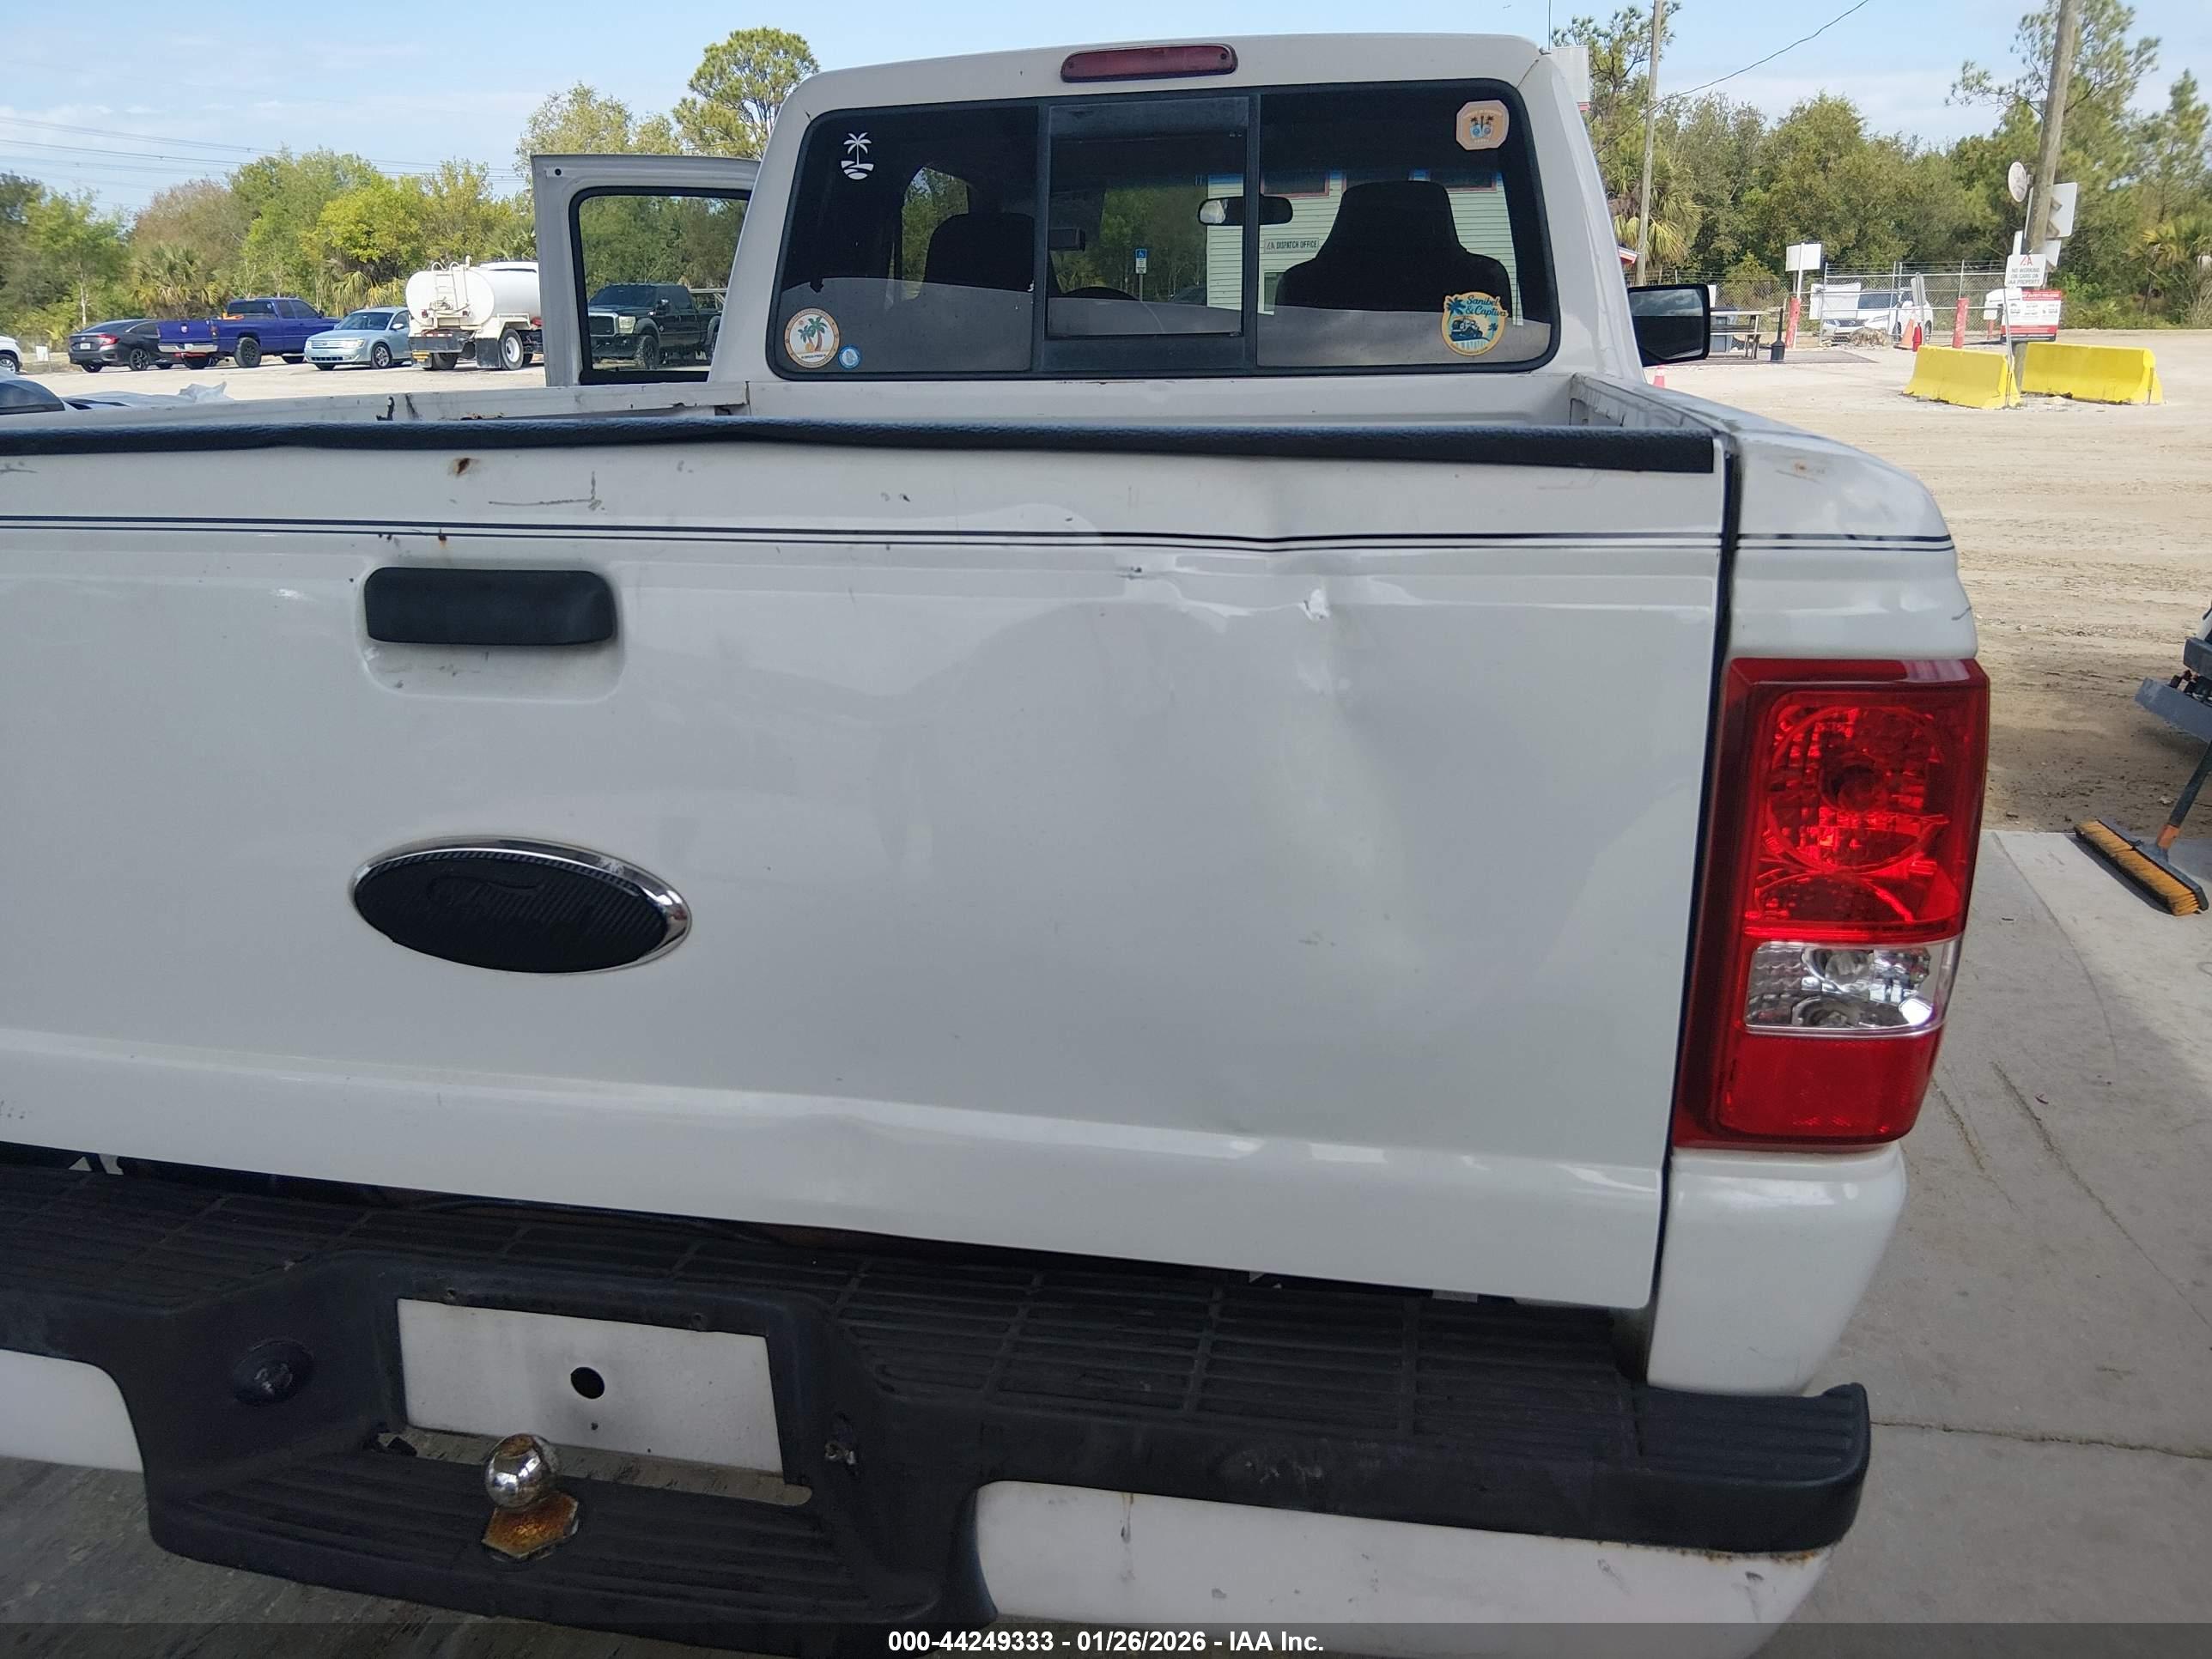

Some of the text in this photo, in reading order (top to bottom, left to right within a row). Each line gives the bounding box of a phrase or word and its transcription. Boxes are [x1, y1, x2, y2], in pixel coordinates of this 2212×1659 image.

[1277, 240, 1298, 249] DISPATCH
[1467, 295, 1499, 307] Sanibel
[1474, 306, 1507, 318] Captiva
